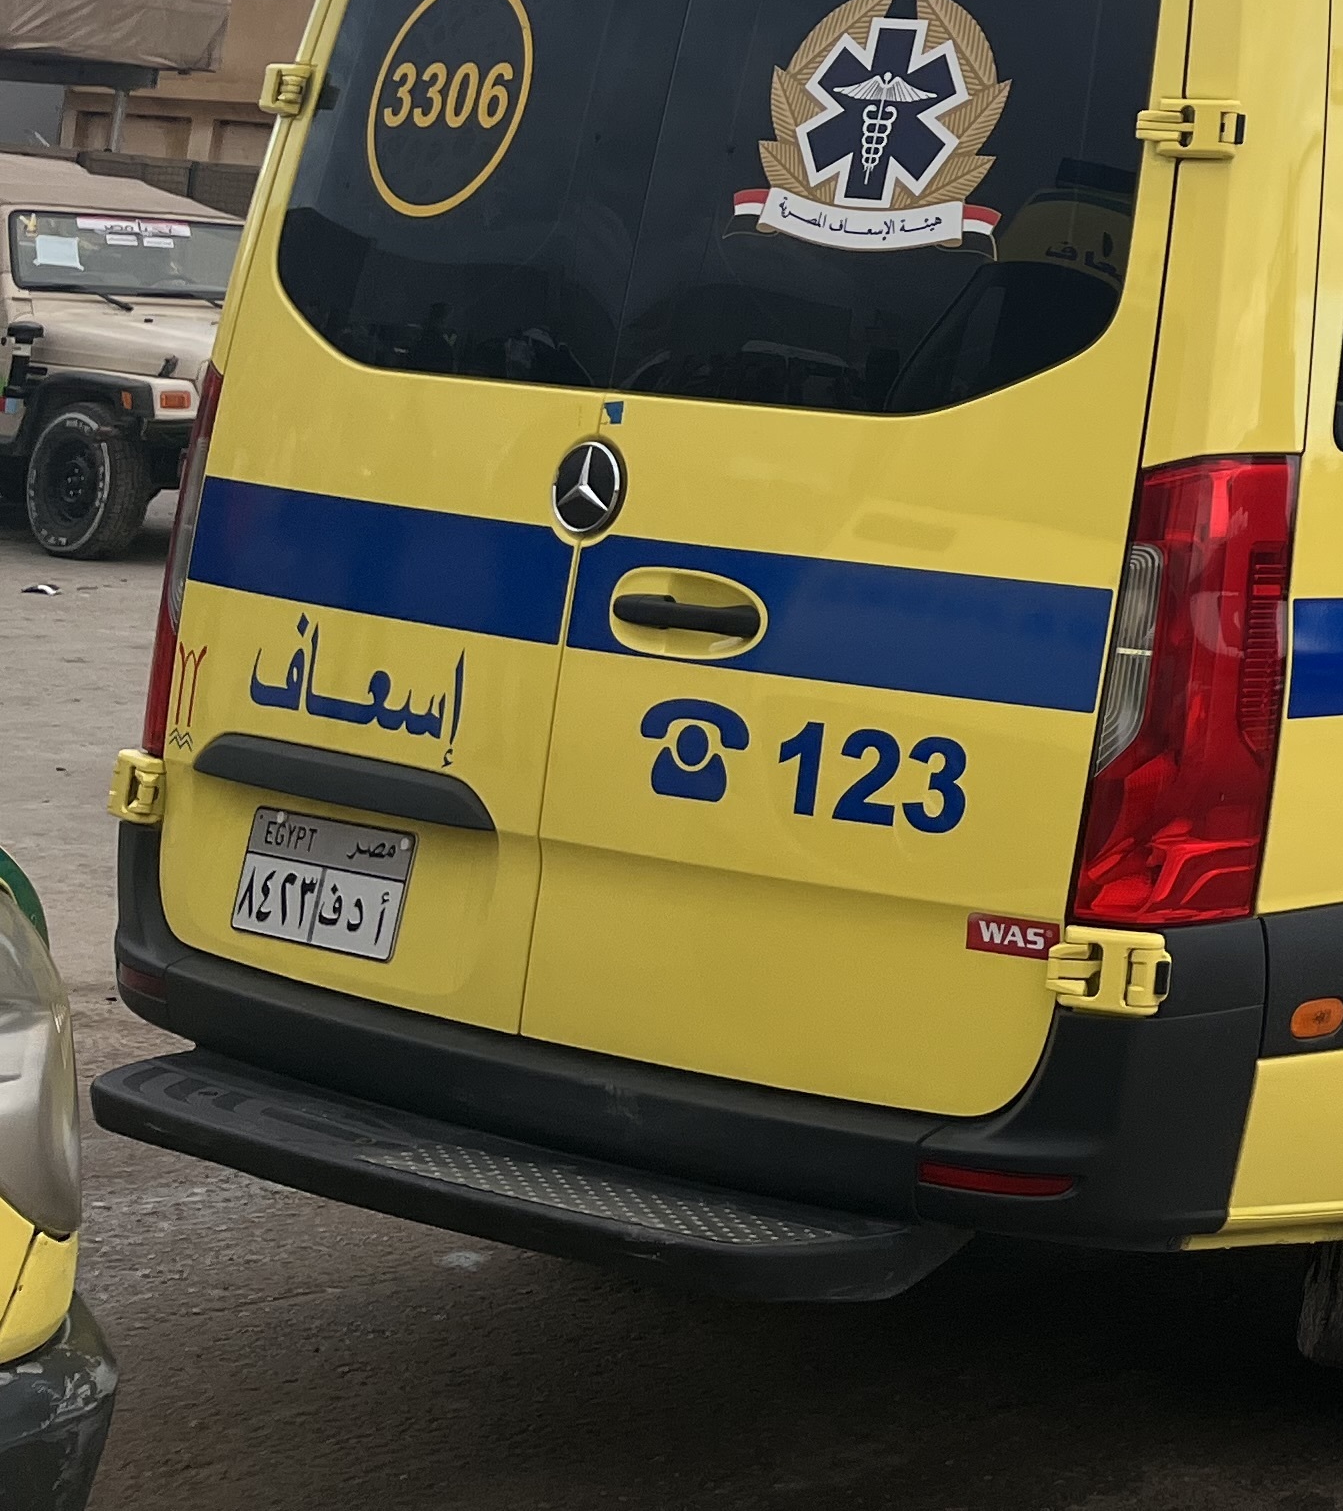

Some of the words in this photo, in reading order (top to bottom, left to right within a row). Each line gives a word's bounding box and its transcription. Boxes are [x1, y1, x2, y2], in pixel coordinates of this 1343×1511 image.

[382, 61, 515, 131] 3306
[778, 196, 828, 230] المصرية
[900, 215, 943, 234] هيئة
[249, 612, 467, 769] إسعاف
[777, 720, 968, 834] 123
[264, 821, 319, 853] EGYPT
[346, 840, 397, 860] مصر
[978, 919, 1047, 952] WAS
